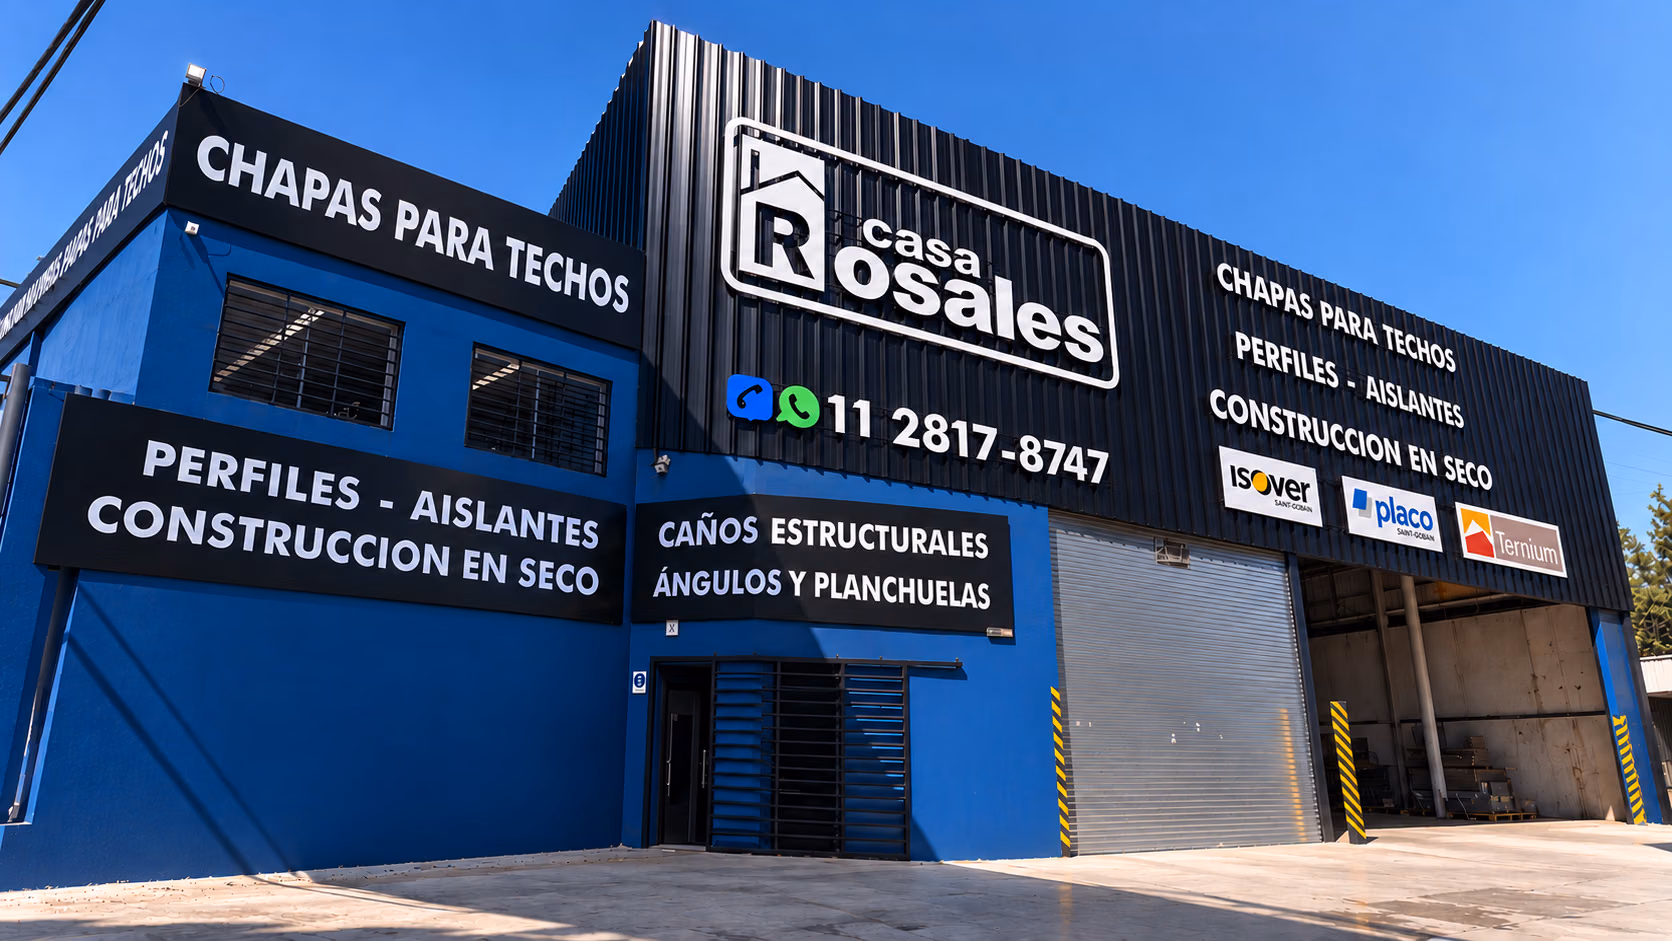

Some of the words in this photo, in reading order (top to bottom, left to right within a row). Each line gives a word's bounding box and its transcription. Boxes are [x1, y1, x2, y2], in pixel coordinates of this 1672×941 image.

[120, 130, 169, 212] TECHOS
[197, 135, 382, 232] CHAPAS
[394, 199, 494, 271] PARA
[505, 236, 630, 314] TECHOS
[862, 218, 981, 279] casa
[1216, 262, 1314, 320] CHAPAS
[1319, 300, 1379, 345] PARA
[1382, 323, 1457, 373] TECHOS
[827, 394, 871, 438] 11
[1234, 330, 1339, 389] PERFILES
[1366, 375, 1465, 429] AISLANTES
[1209, 388, 1401, 467] CONSTRUCCION
[1407, 444, 1438, 477] EN
[1443, 455, 1493, 491] SECO
[142, 439, 360, 511] PERFILES
[409, 490, 599, 550] AISLANTES
[658, 511, 758, 548] CAÑOS
[770, 516, 989, 560] ESTRUCTURALES
[1374, 495, 1434, 532] placo
[86, 495, 450, 577] CONSTRUCCION
[462, 549, 508, 584] EN
[518, 557, 600, 596] SECO
[1494, 529, 1559, 565] Ternium
[652, 566, 782, 598] ÁNGULOS
[788, 570, 807, 597] Y
[814, 571, 991, 610] PLANCHUELAS
